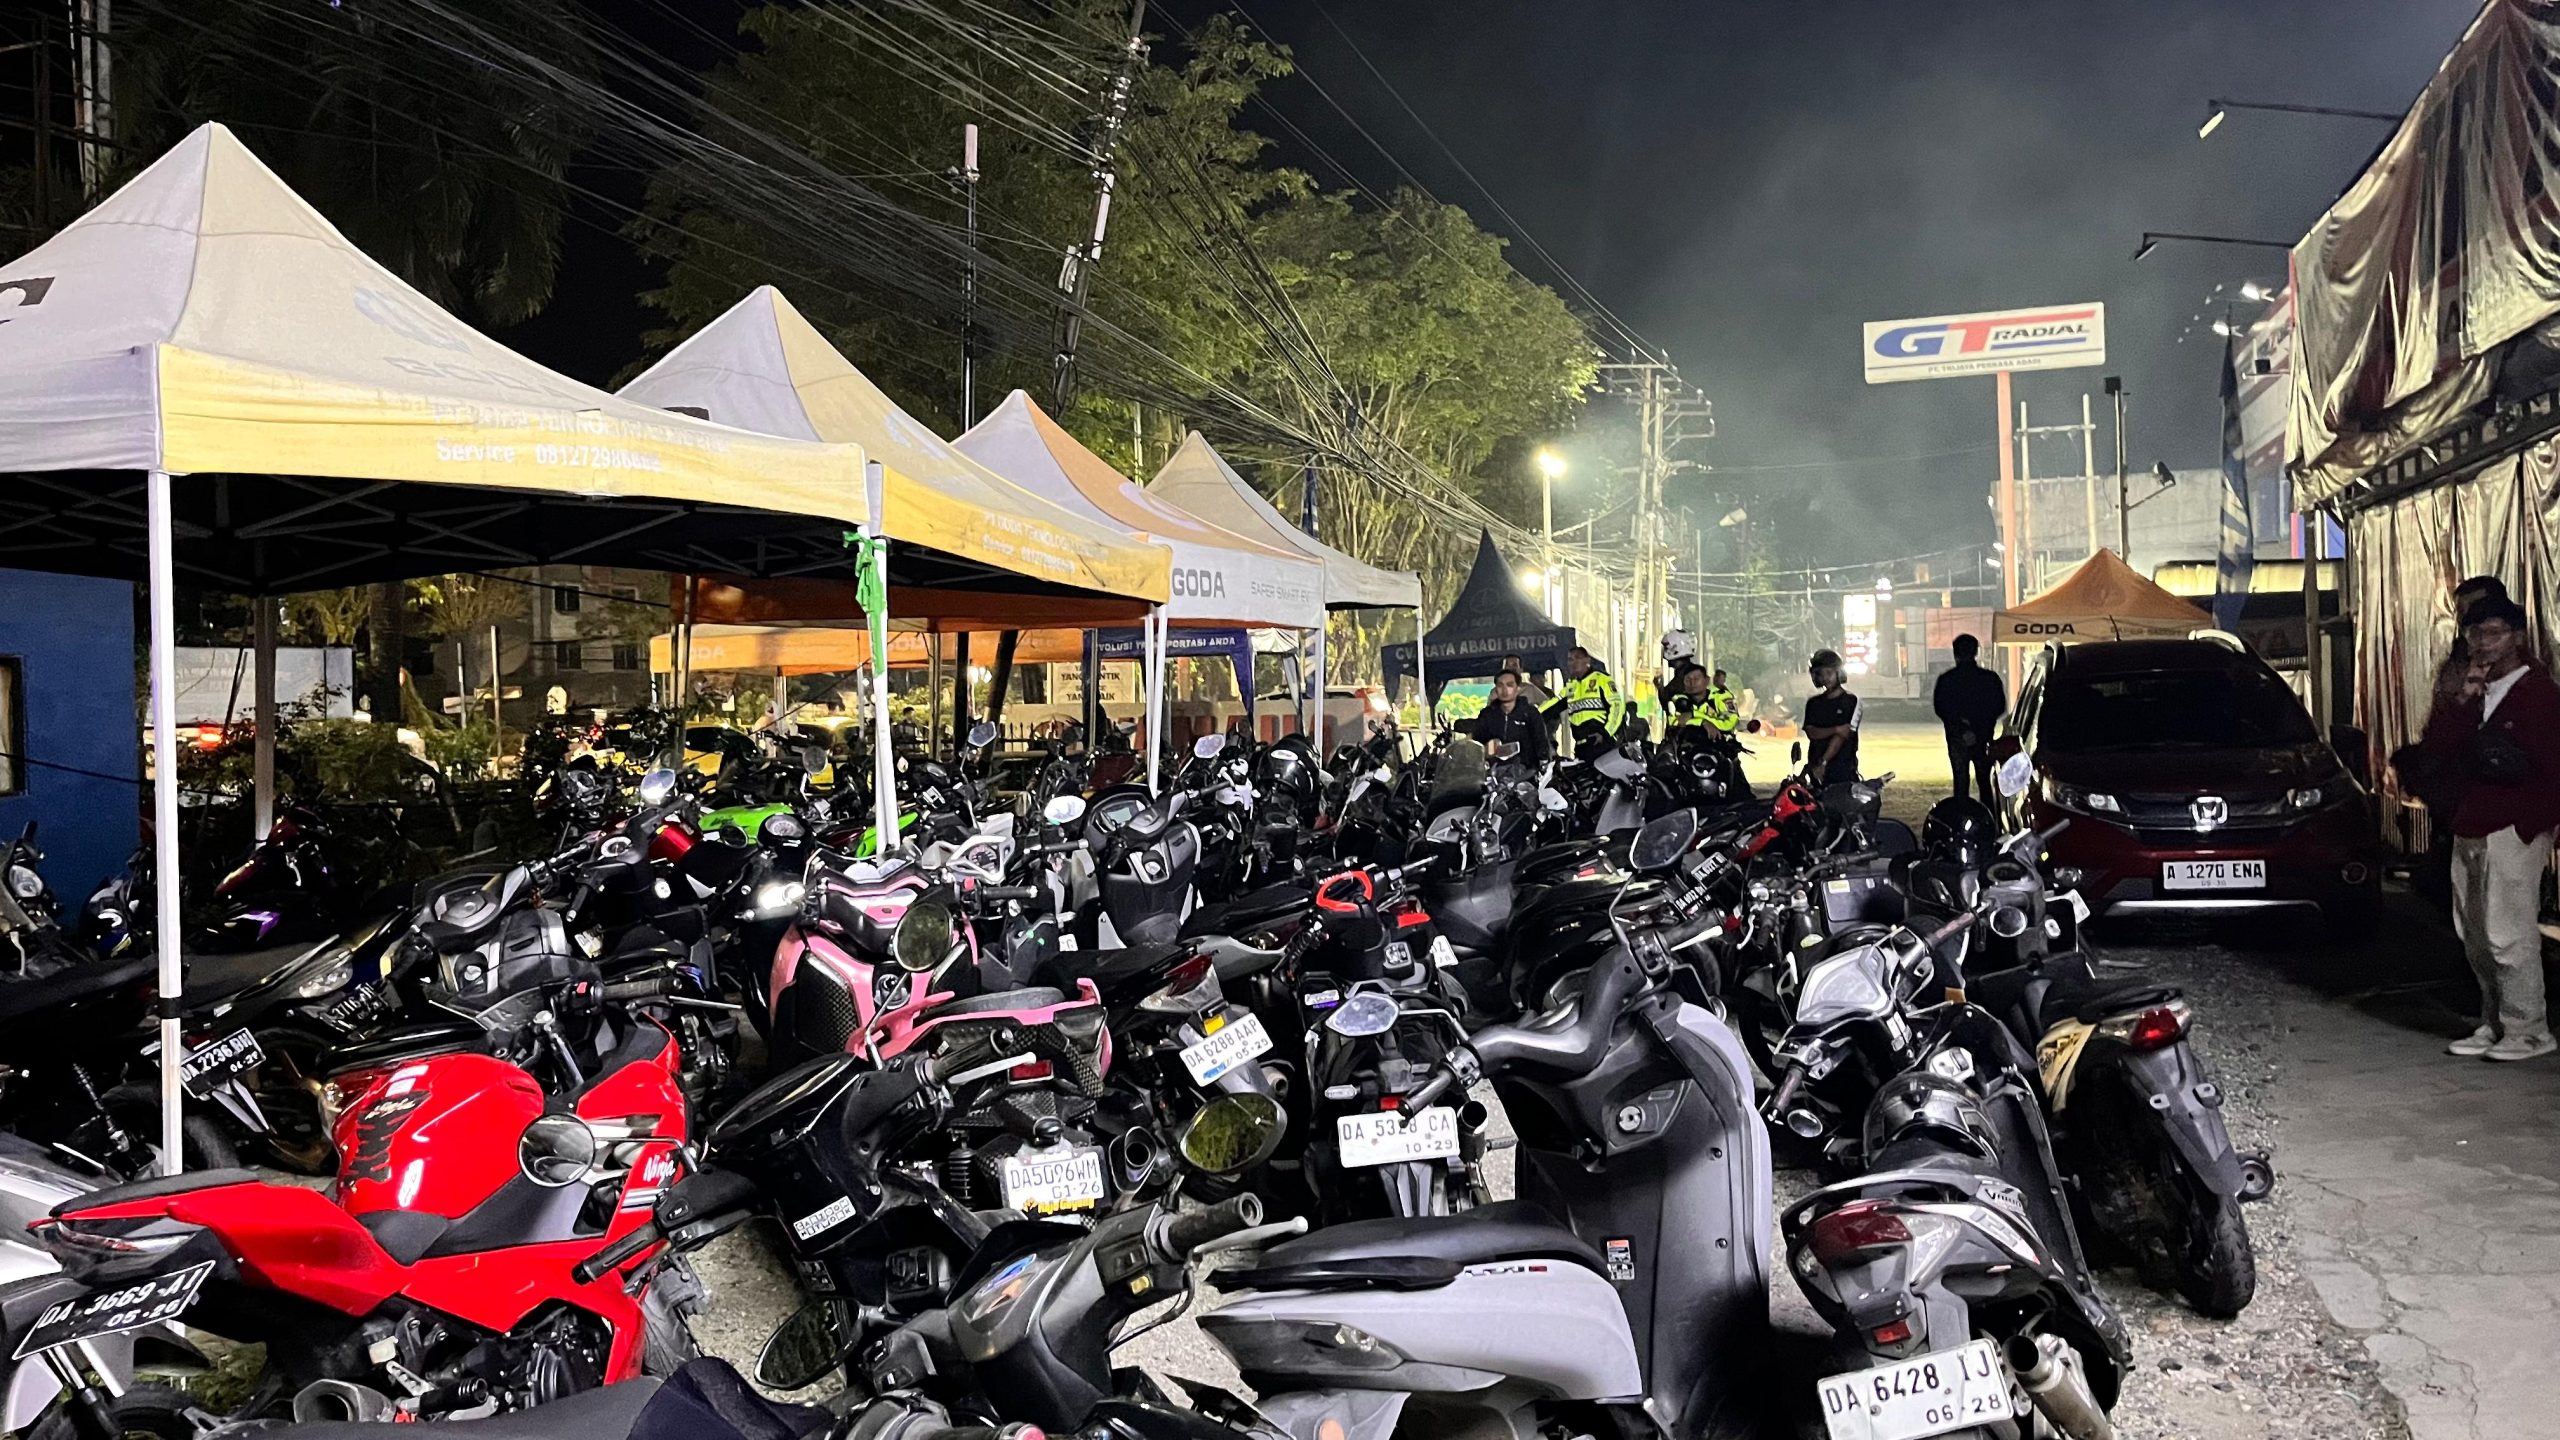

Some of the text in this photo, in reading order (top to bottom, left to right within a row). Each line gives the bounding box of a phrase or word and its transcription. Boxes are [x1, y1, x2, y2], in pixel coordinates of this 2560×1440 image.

[1993, 324, 2090, 341] RADIAL
[436, 437, 516, 463] Service
[1172, 568, 1225, 598] GODA
[2014, 622, 2075, 636] GODA
[1098, 640, 1133, 652] VOLUSI
[1208, 636, 1236, 647] ANDA
[1460, 638, 1501, 655] ABADI
[1506, 634, 1558, 651] MOTOR
[2167, 862, 2263, 879] A 1270 ENA
[1185, 1018, 1258, 1068] DA 6288 AAP
[197, 1044, 234, 1073] 2236
[1342, 1121, 1365, 1141] DA
[1428, 1113, 1450, 1132] CA
[642, 1152, 676, 1187] Ninja
[37, 1300, 76, 1329] DA
[84, 1281, 157, 1316] 3669
[1825, 1383, 1861, 1415] DA
[1873, 1362, 1940, 1402] 6428
